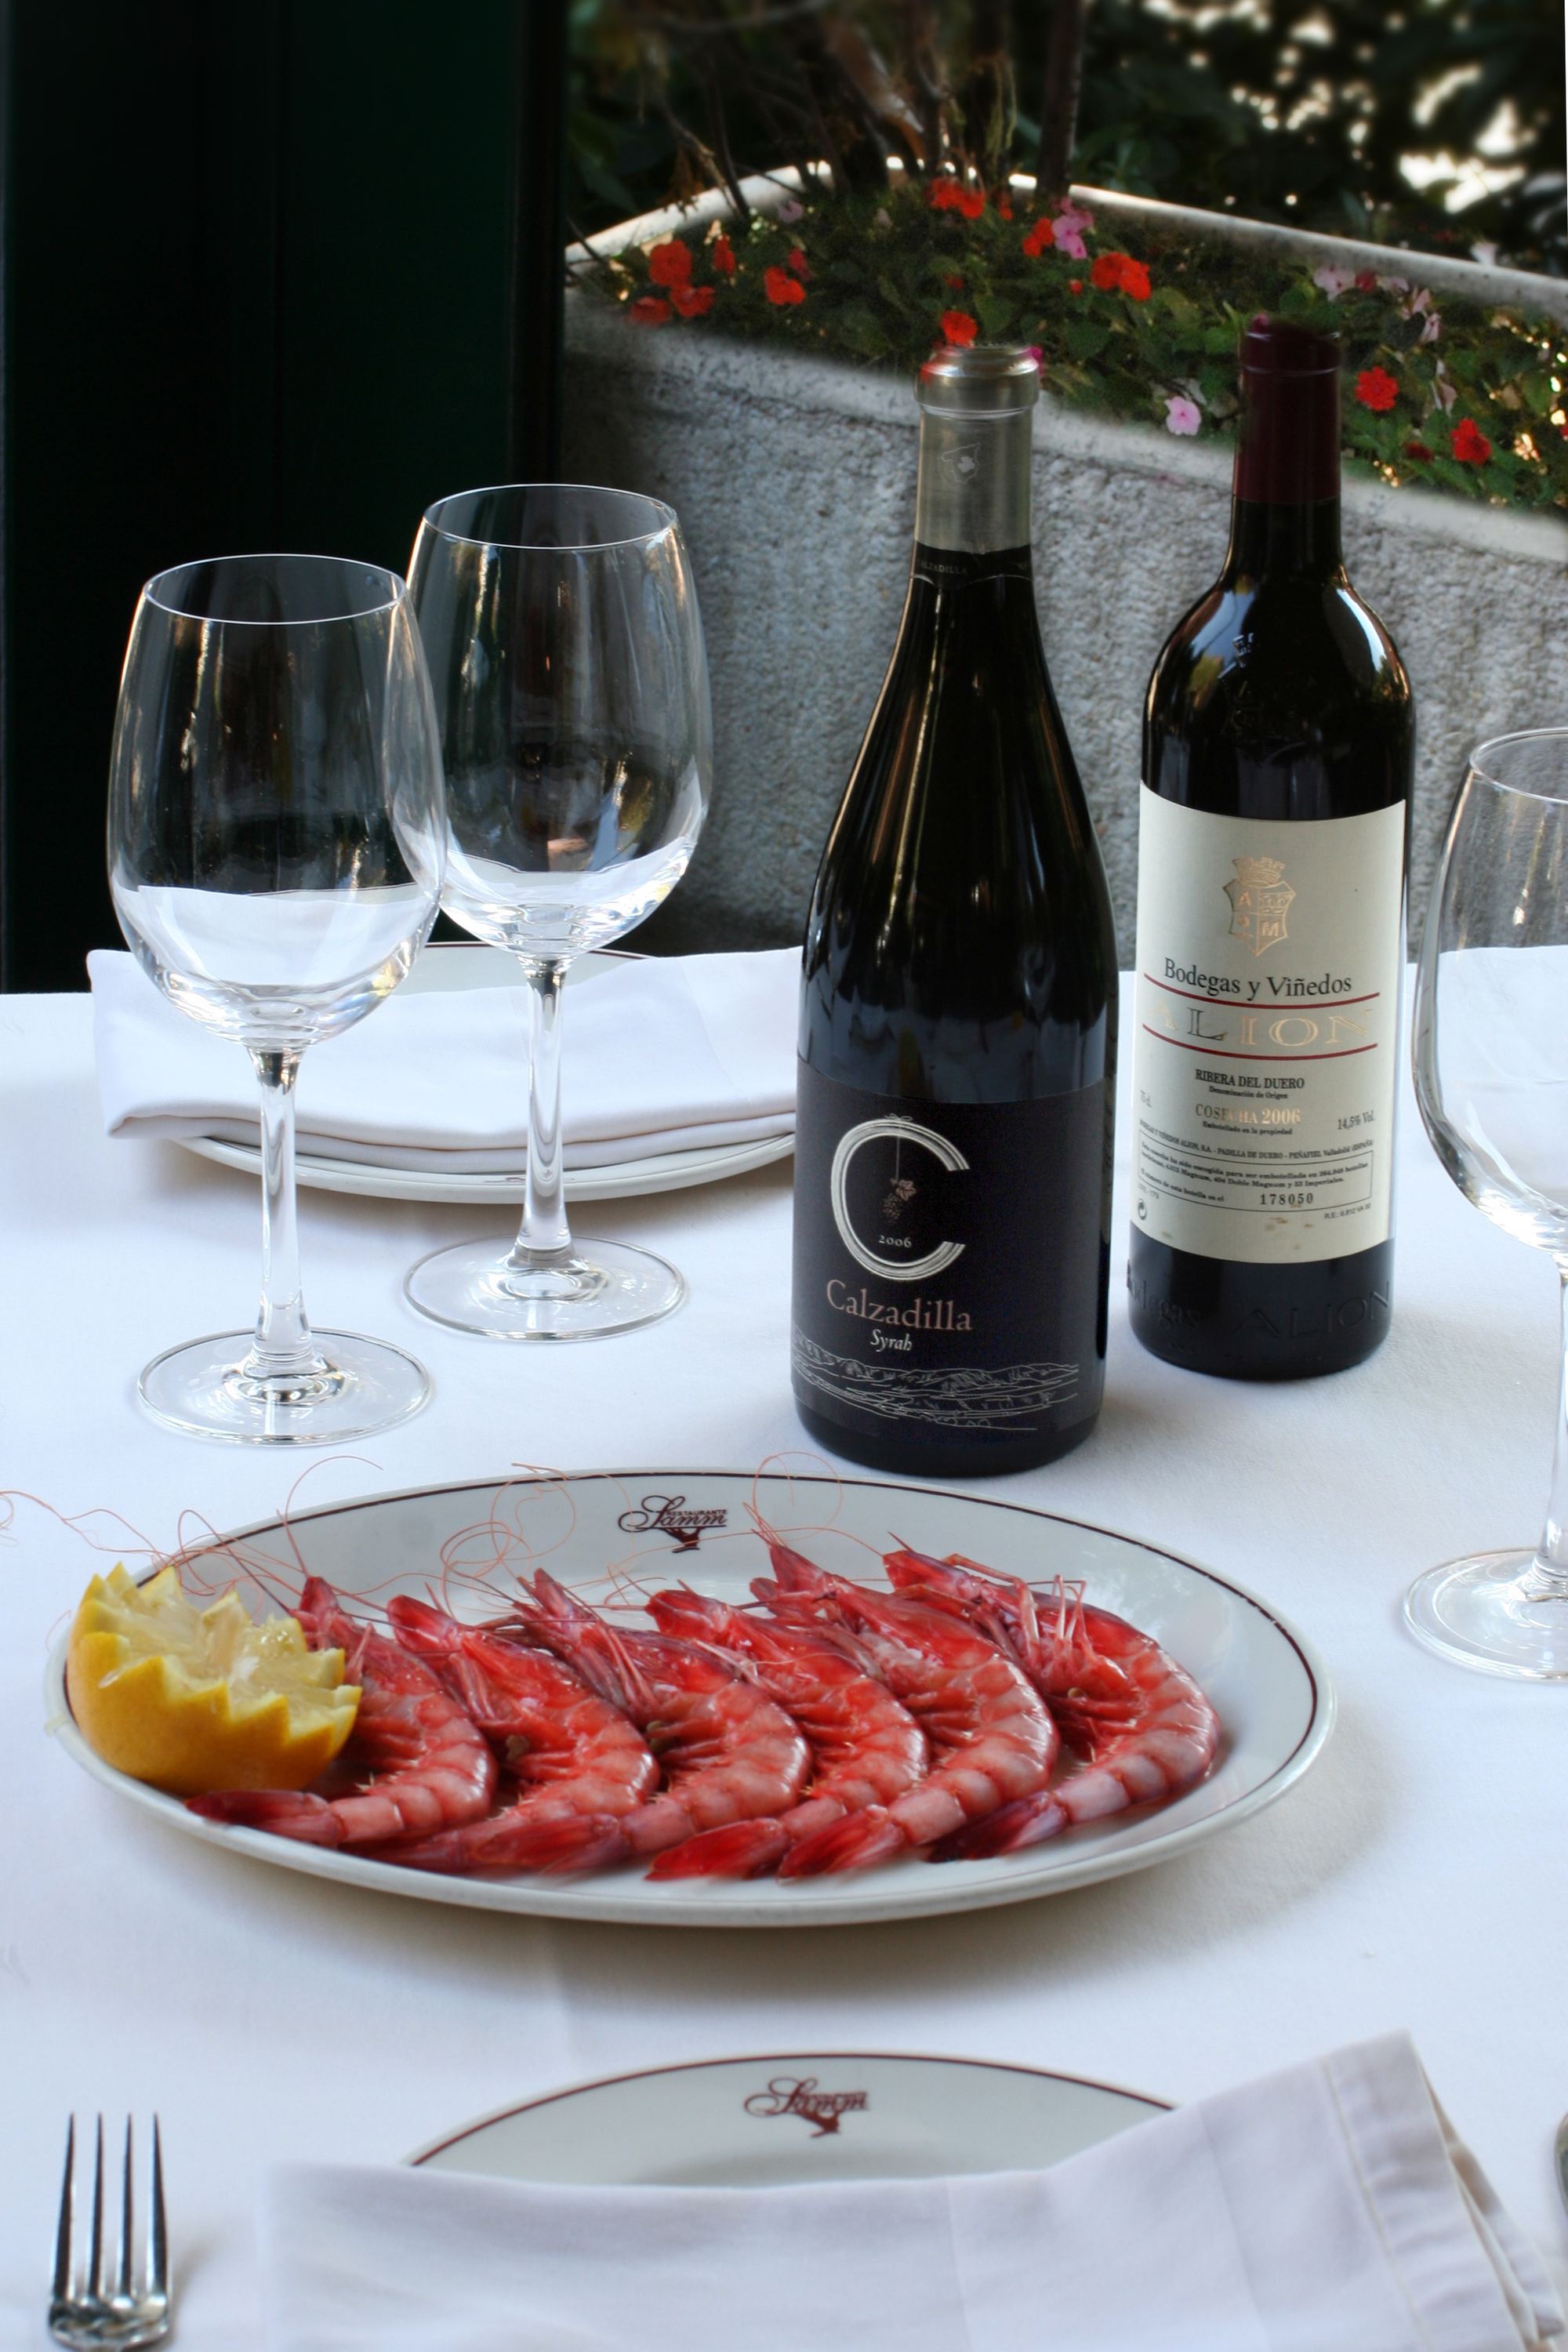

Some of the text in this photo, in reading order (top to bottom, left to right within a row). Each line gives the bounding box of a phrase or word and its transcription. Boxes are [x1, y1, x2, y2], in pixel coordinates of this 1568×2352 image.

[1164, 957, 1352, 1000] Bodegas y Viñedos
[1196, 1069, 1305, 1089] RIBERA DEL DUERO
[1196, 1103, 1301, 1124] COSECHA 2006
[1338, 1116, 1360, 1130] 14,5%
[1259, 1192, 1314, 1205] 178050
[878, 1235, 913, 1249] 2006
[826, 1279, 973, 1330] Calzadilla
[870, 1329, 913, 1352] Syrah
